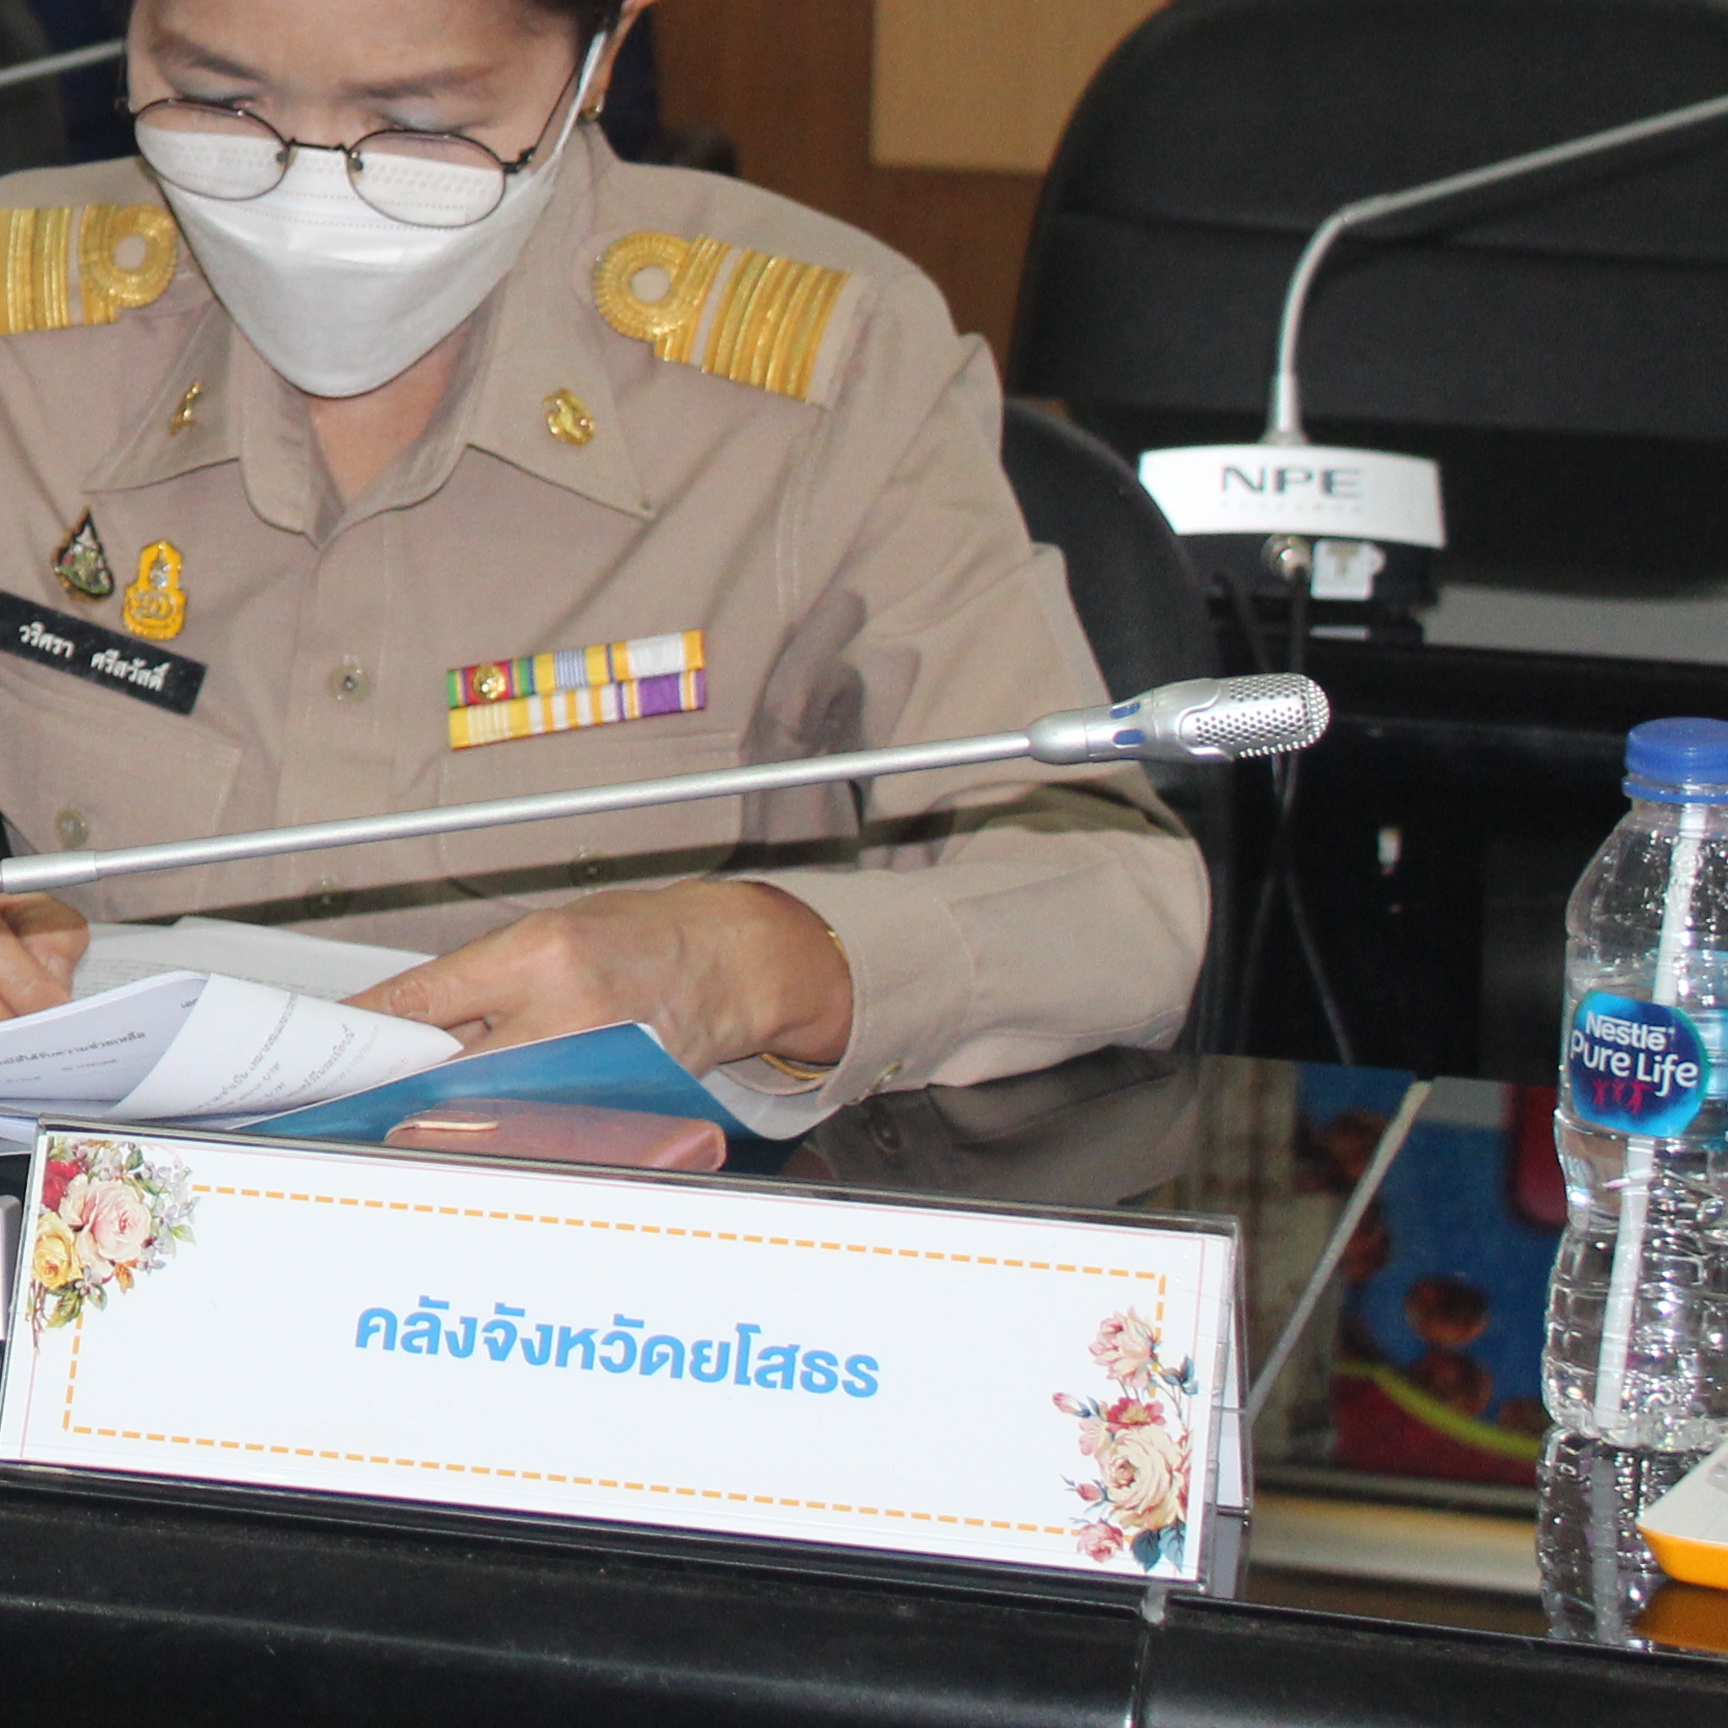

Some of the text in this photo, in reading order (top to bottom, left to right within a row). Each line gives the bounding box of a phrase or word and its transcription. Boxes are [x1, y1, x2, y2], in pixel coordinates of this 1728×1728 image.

[1221, 466, 1363, 498] NPE
[1570, 1029, 1699, 1098] Pure Life
[354, 1294, 881, 1399] คลังจังหวัดยโสธร
